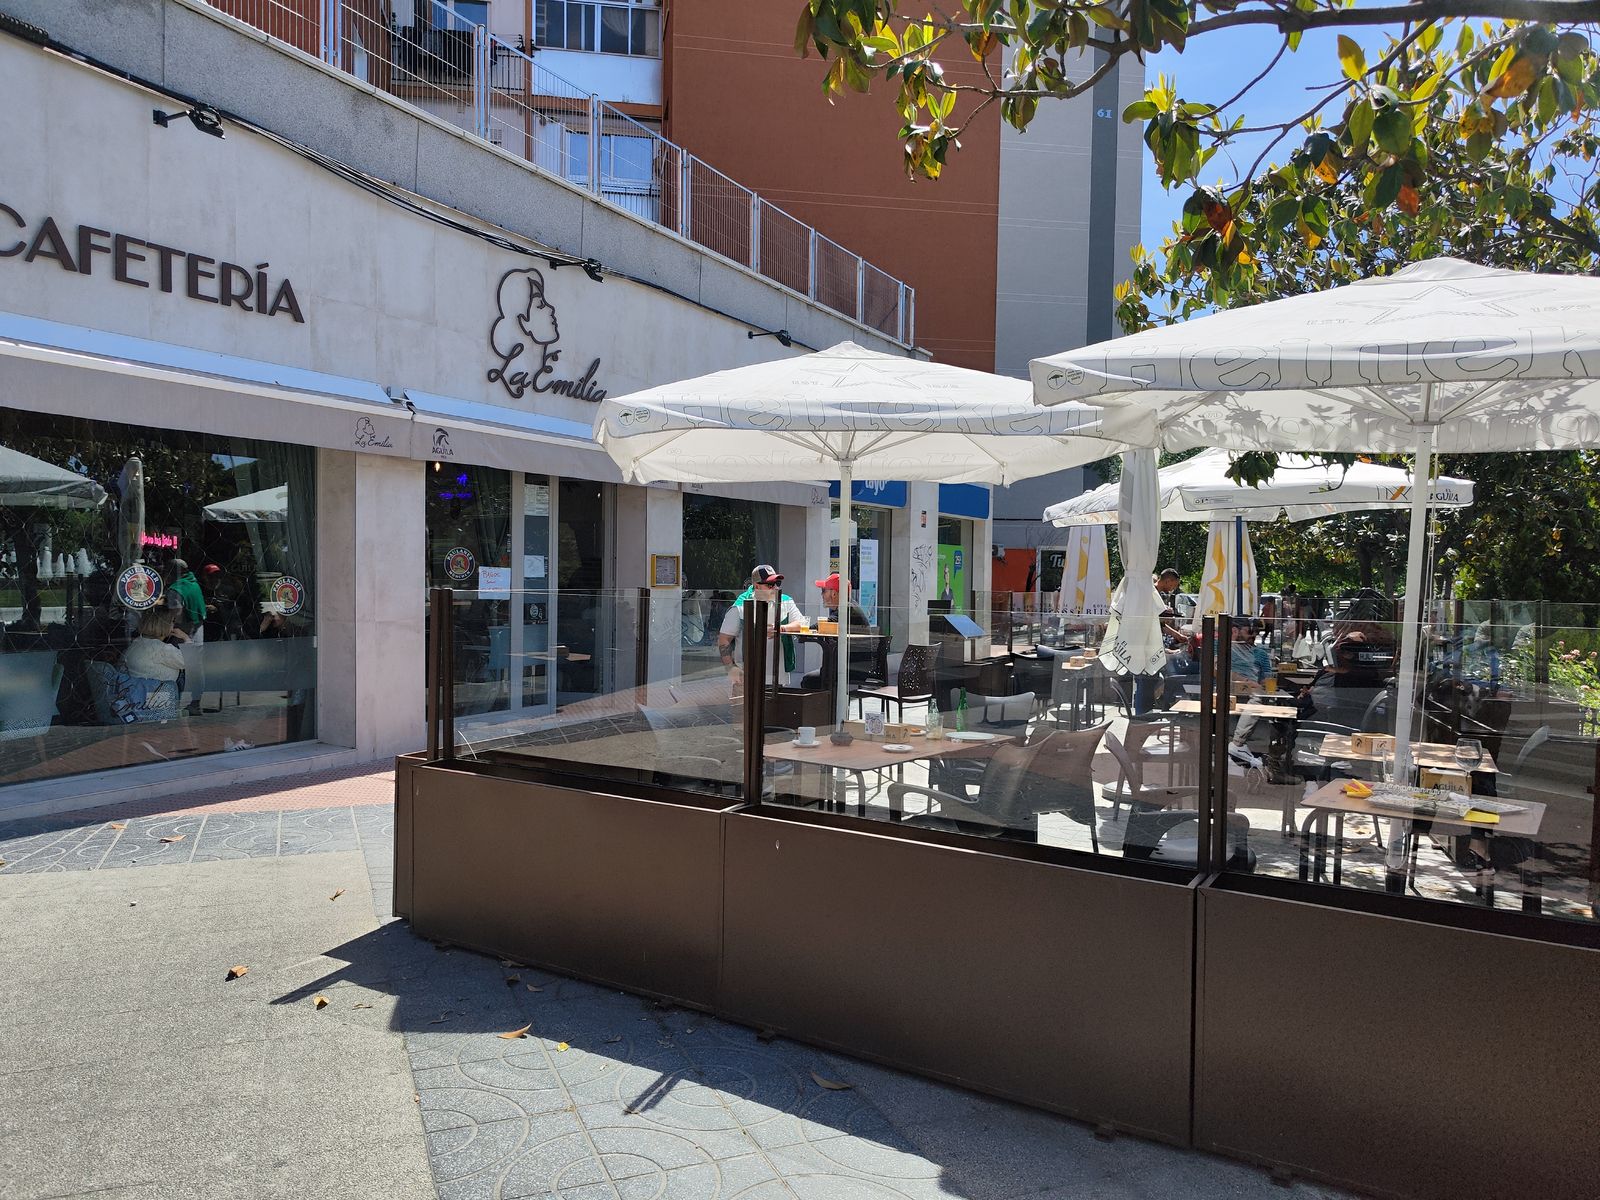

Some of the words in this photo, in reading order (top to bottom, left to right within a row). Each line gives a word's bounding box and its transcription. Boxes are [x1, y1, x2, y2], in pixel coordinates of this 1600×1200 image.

[1096, 108, 1113, 119] 61
[487, 342, 532, 399] La
[121, 566, 160, 583] PAULANER
[272, 578, 302, 592] PAULANER
